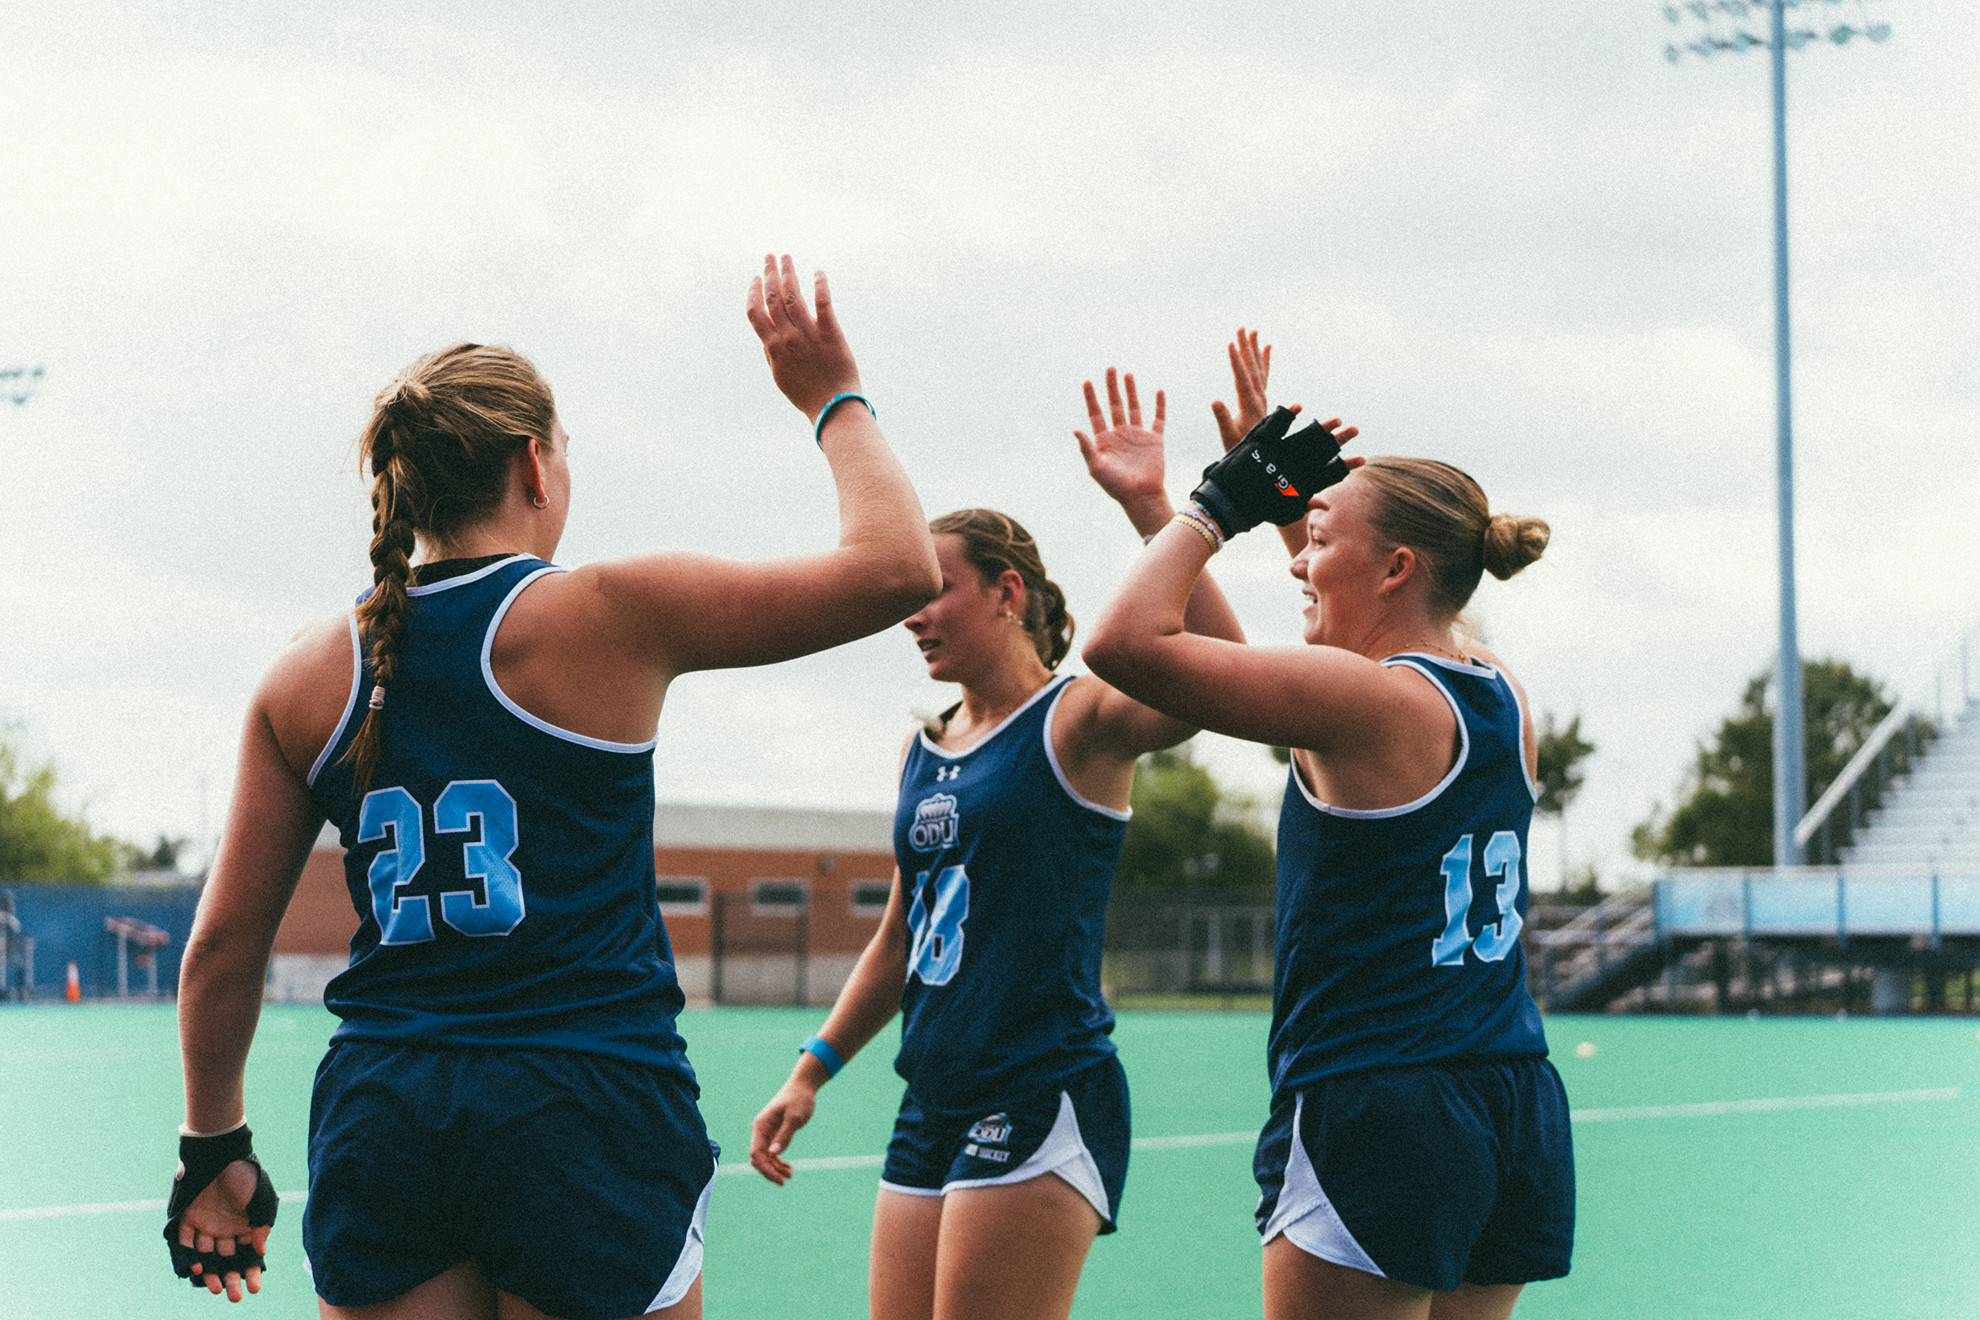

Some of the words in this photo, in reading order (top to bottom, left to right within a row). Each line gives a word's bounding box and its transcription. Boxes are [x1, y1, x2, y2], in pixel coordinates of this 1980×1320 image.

[357, 779, 526, 946] 23
[912, 819, 954, 846] ODU
[905, 864, 971, 987] 18
[1432, 830, 1524, 968] 13
[972, 1125, 1007, 1142] ODU
